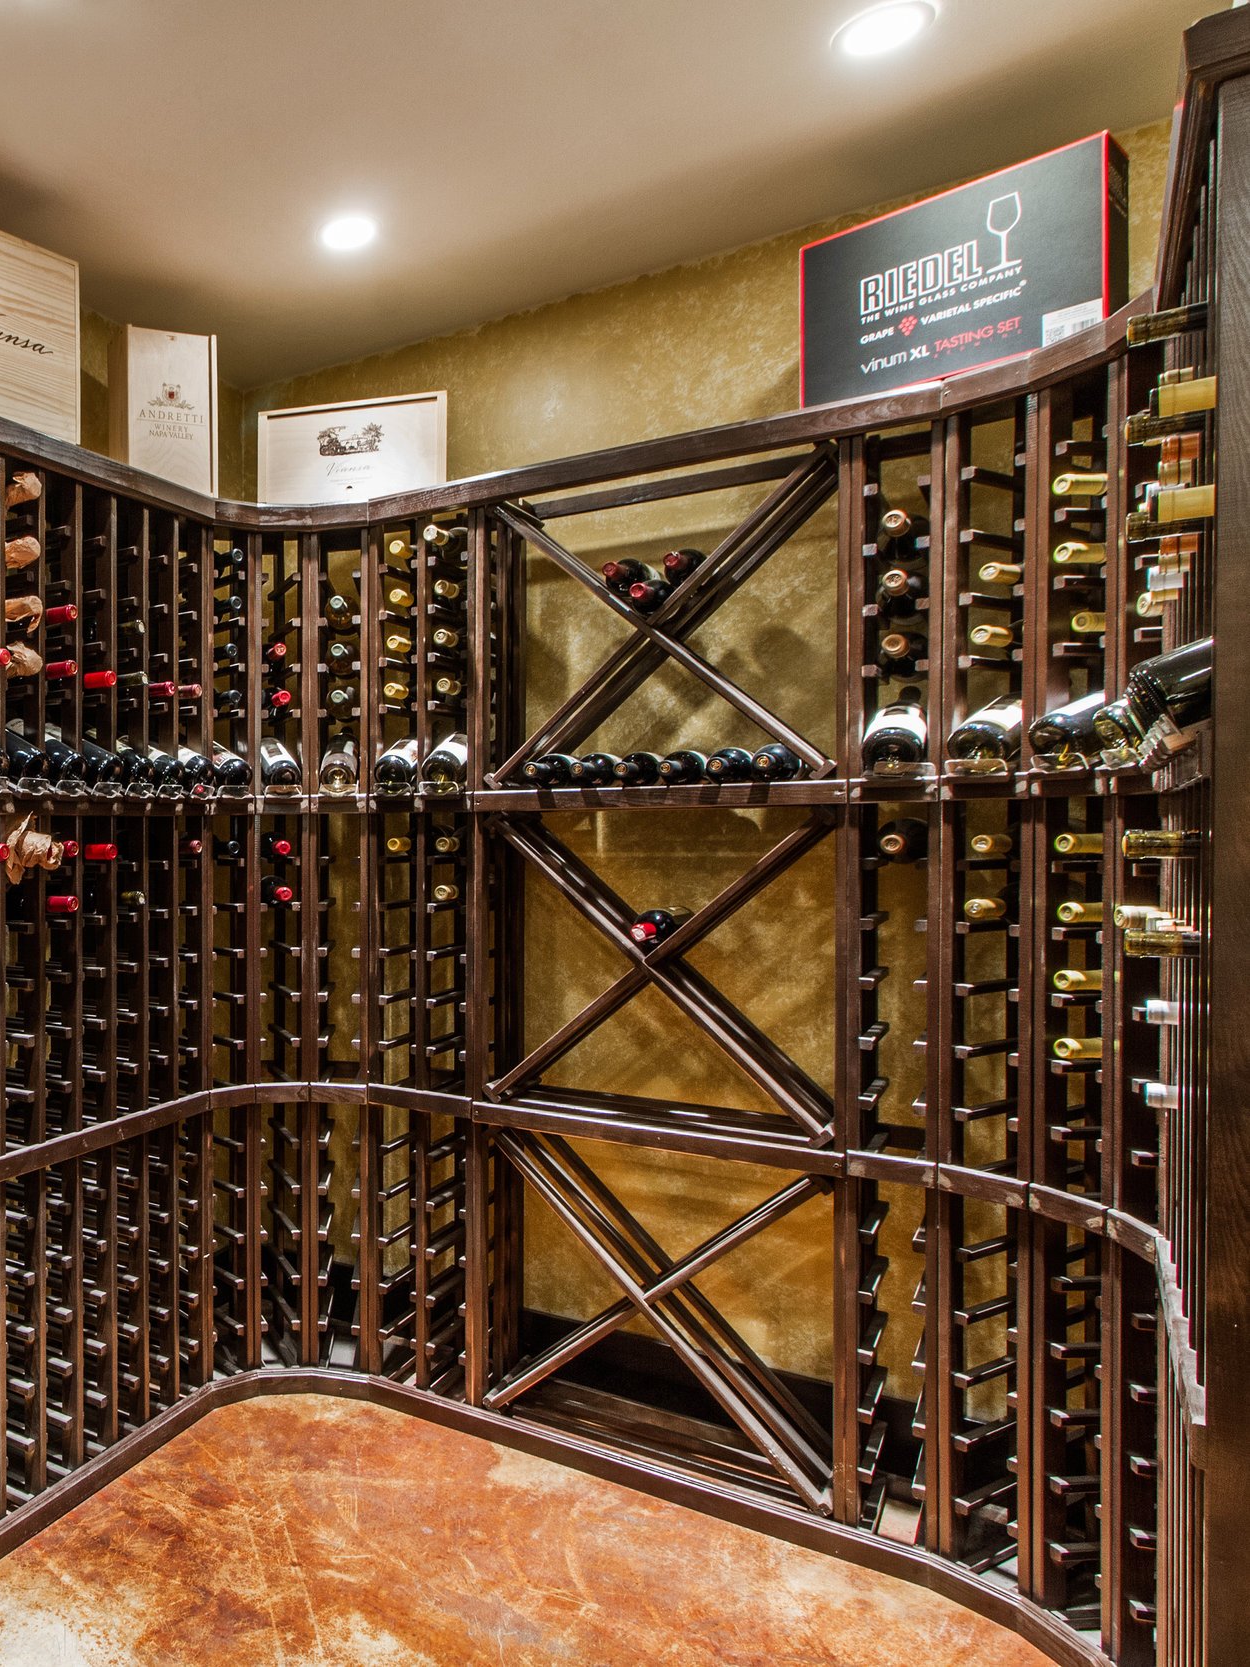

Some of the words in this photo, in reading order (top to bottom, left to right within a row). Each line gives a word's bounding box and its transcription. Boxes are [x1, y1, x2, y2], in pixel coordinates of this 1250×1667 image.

[860, 239, 983, 316] RIEDEL
[861, 313, 881, 326] THE
[884, 300, 915, 318] WINE
[918, 287, 957, 306] GLASS
[960, 264, 1023, 293] COMPANY
[920, 303, 973, 326] VARIETAL
[860, 326, 896, 345] GRAPE
[909, 344, 932, 362] XL
[934, 324, 995, 353] TASTING
[996, 315, 1023, 335] SET
[139, 409, 204, 424] ANDRETTI
[149, 430, 168, 439] NAPA
[169, 431, 194, 441] VALLEY
[154, 423, 189, 434] WINERY
